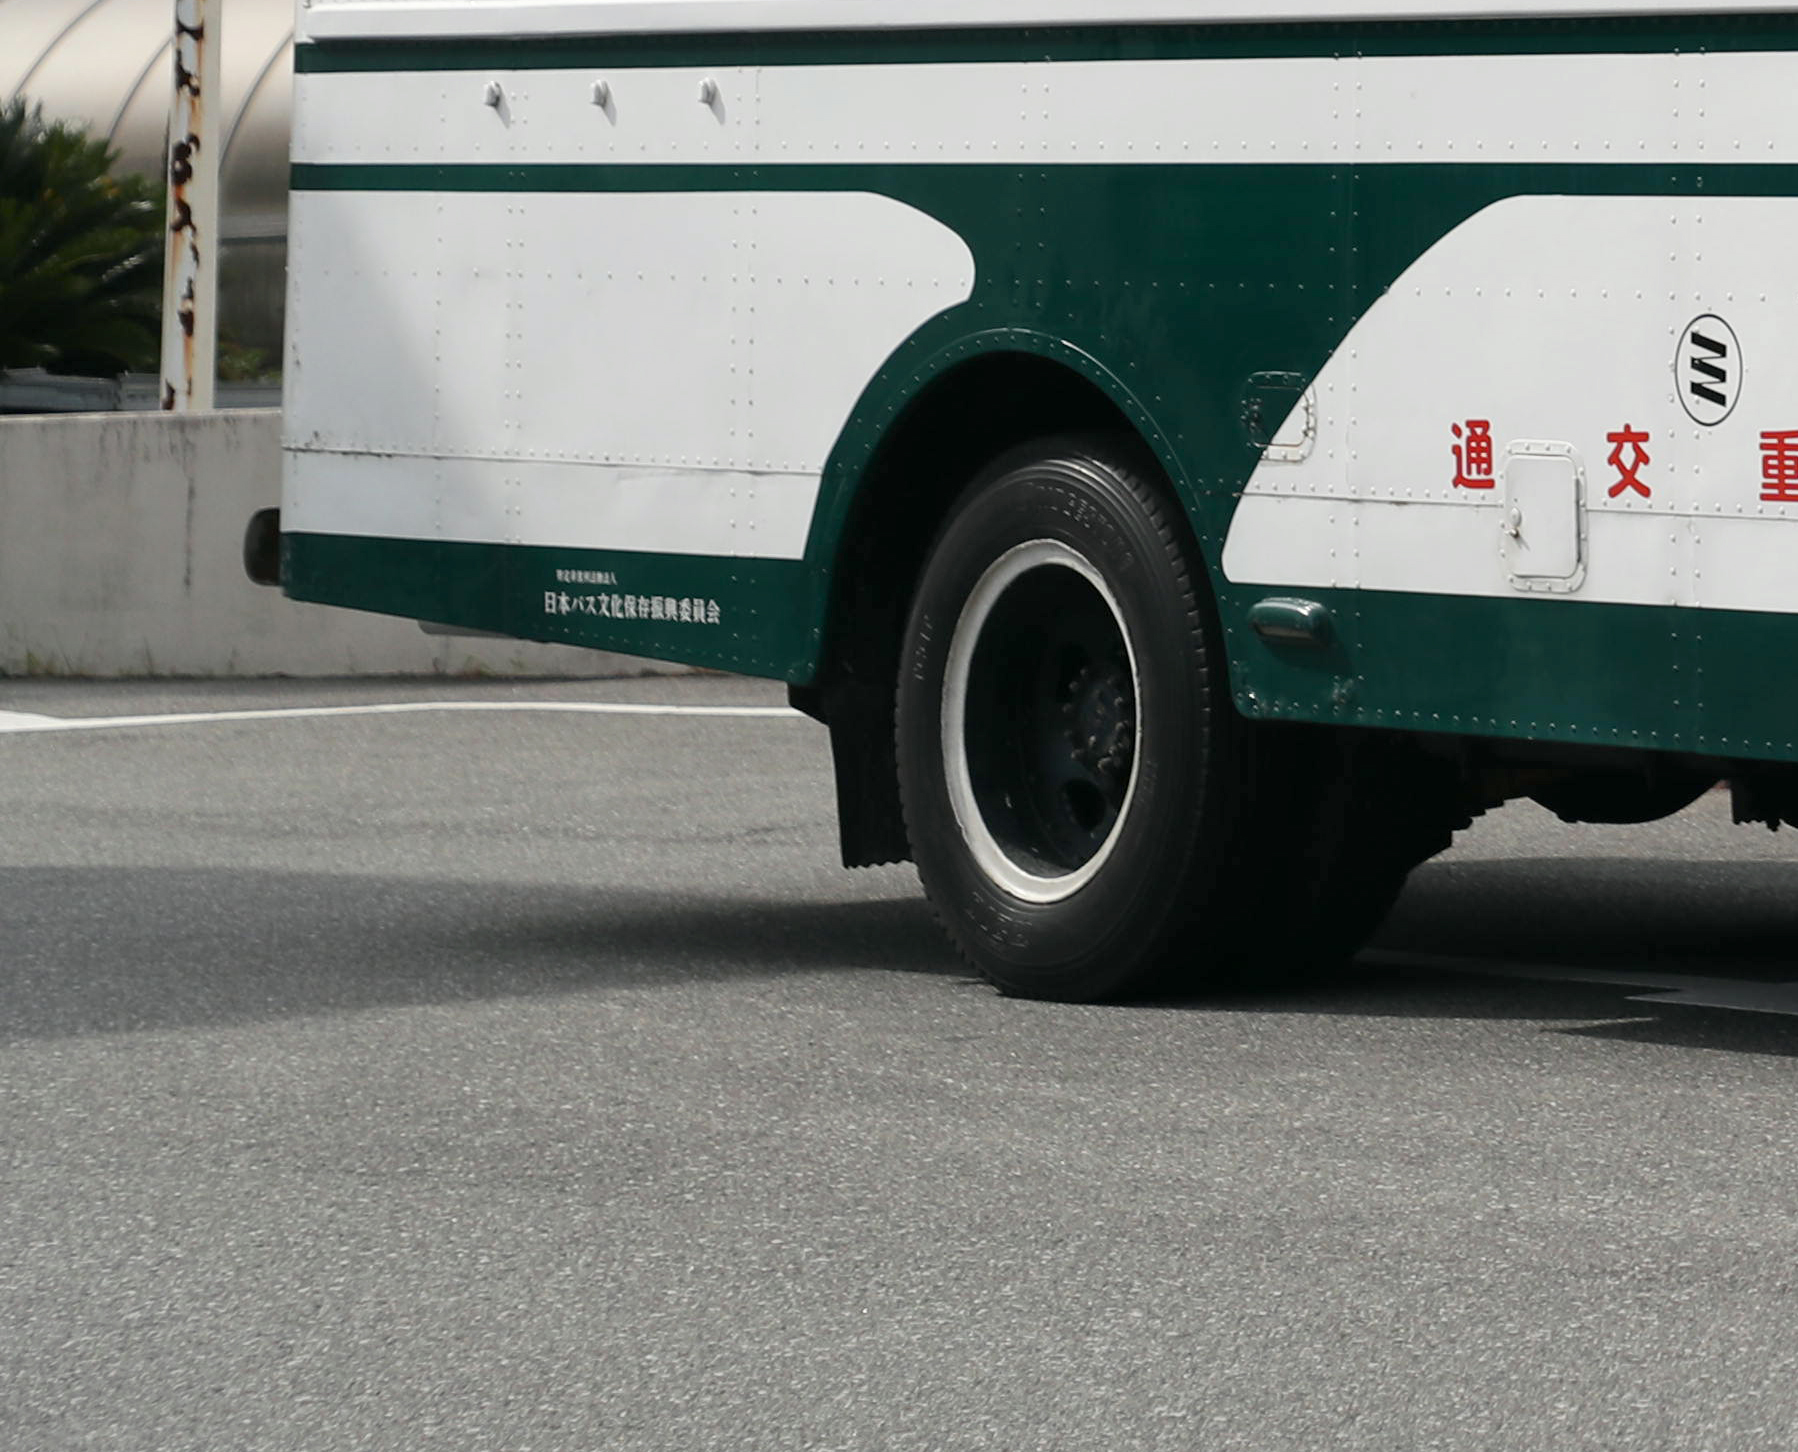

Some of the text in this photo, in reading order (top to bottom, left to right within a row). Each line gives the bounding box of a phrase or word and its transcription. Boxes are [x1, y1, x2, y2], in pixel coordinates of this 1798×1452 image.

[544, 590, 721, 625] 日本バス文化保存振興委員会
